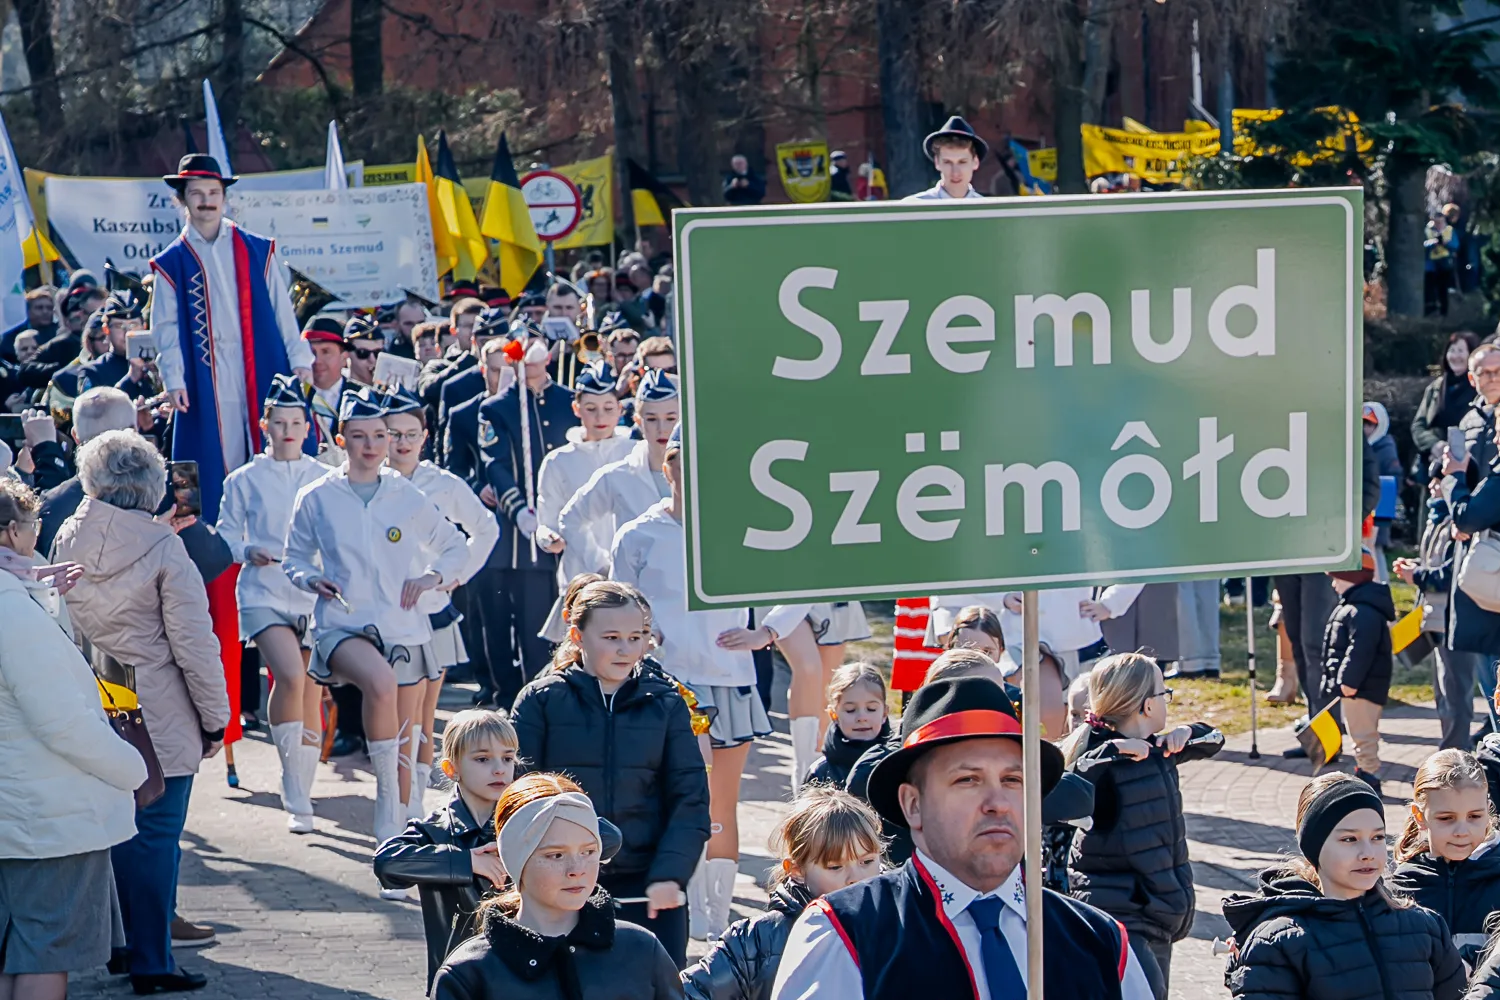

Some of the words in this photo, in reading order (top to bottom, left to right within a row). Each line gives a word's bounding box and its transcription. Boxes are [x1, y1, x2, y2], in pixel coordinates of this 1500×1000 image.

[280, 244, 323, 256] Gmina
[329, 241, 384, 255] Szemud
[772, 248, 1275, 380] Szemud
[743, 412, 1307, 550] Szëmôłd
